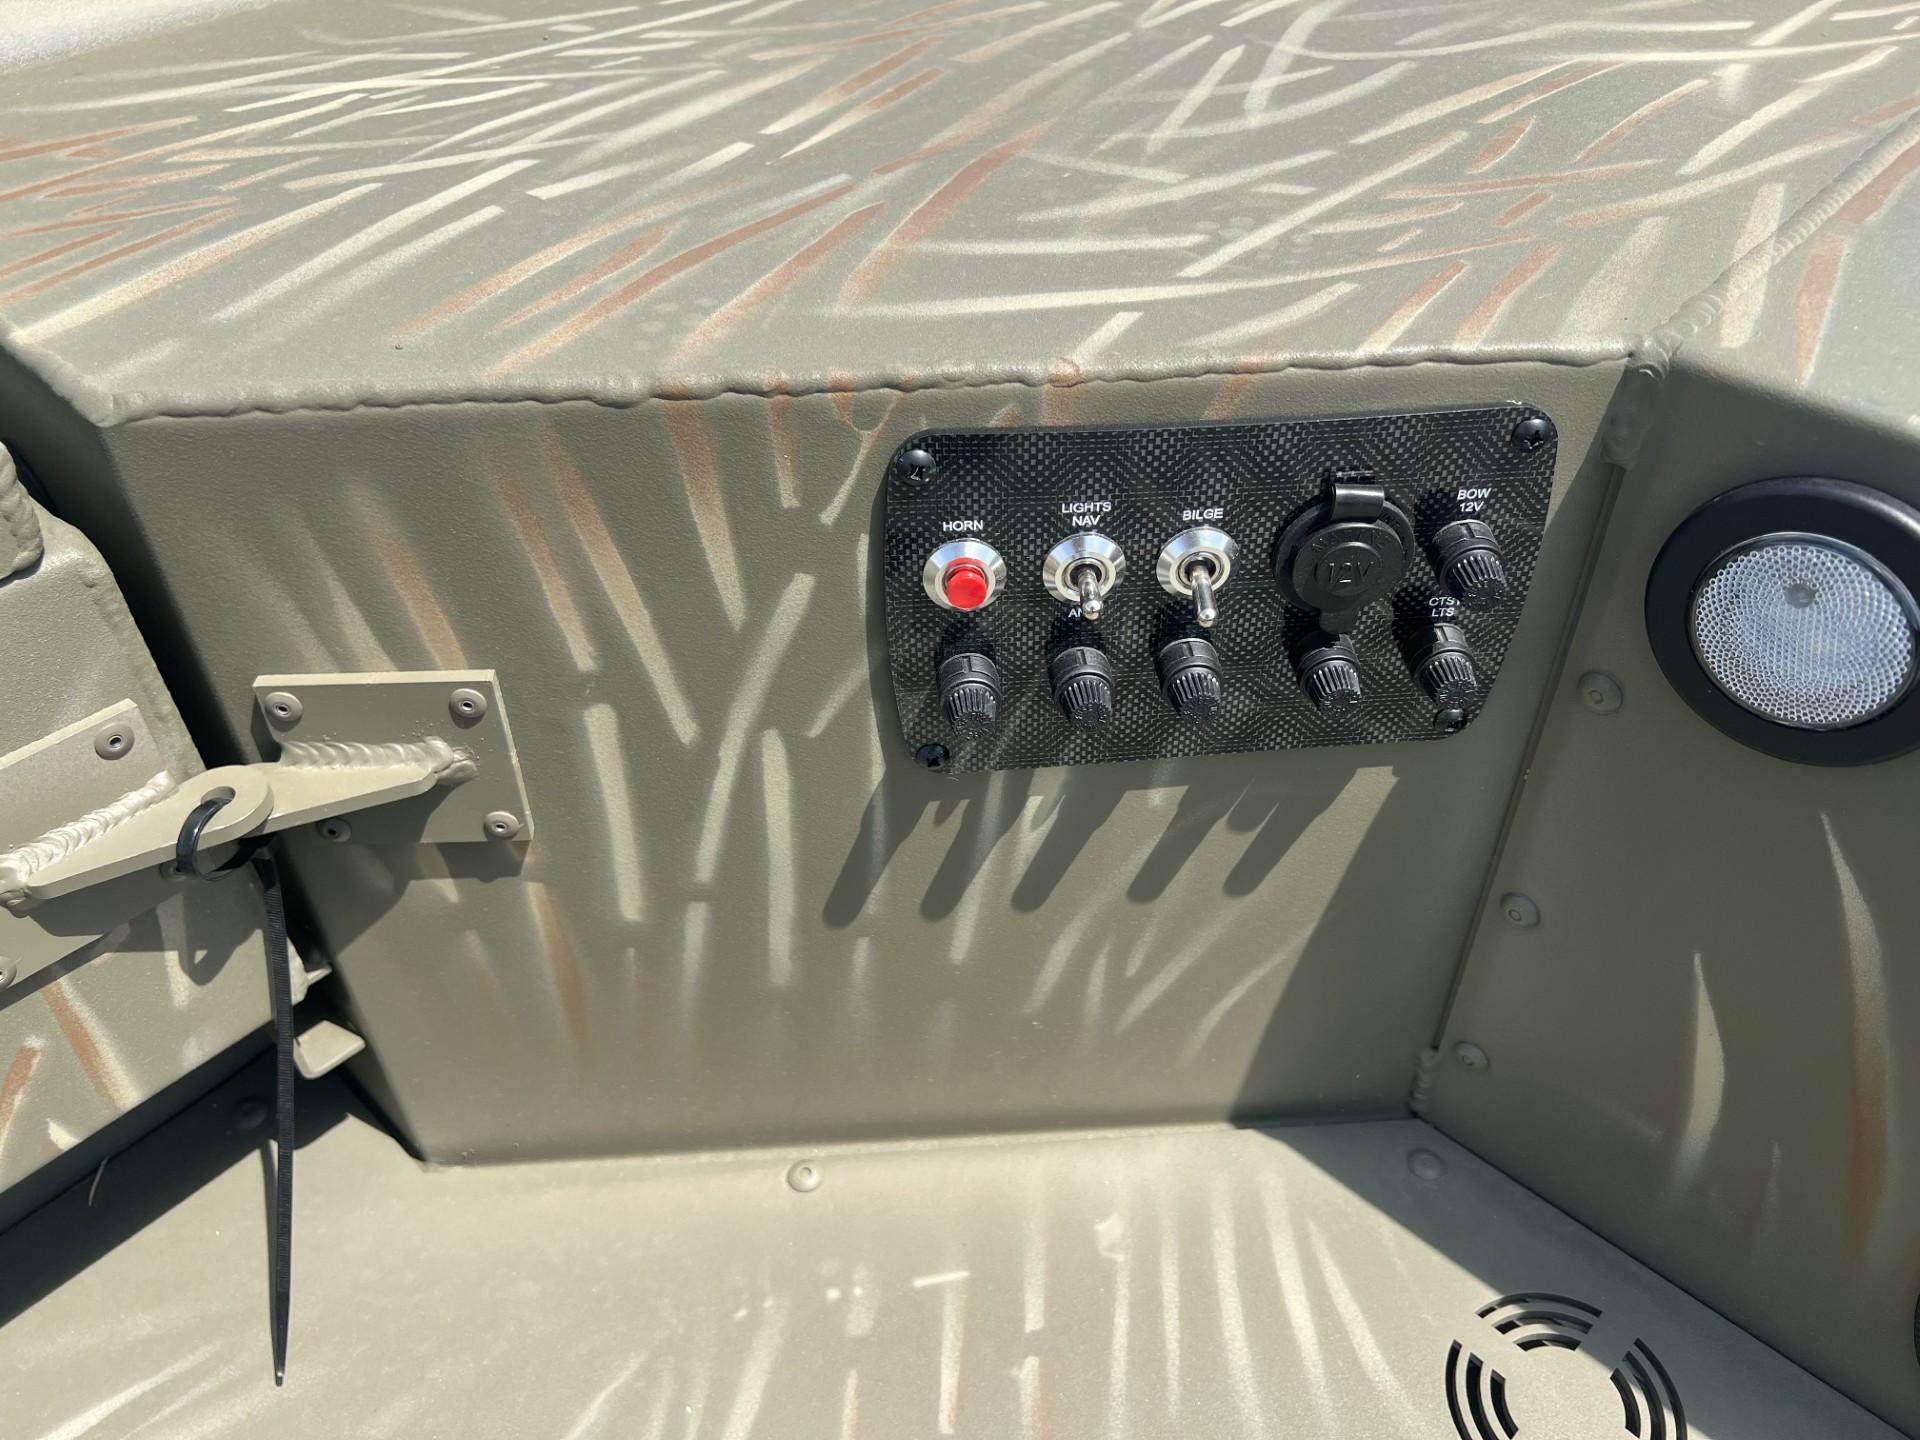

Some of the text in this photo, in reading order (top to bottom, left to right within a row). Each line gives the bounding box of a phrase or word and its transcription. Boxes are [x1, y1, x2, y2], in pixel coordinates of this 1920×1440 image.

[1457, 488, 1492, 500] BOW
[1062, 501, 1112, 513] LIGHTS
[1460, 501, 1485, 512] 12V
[1072, 514, 1101, 526] NAV
[1182, 508, 1224, 521] BILGE
[942, 519, 984, 532] HORN
[1329, 561, 1375, 583] 12V
[1431, 607, 1455, 617] LTS
